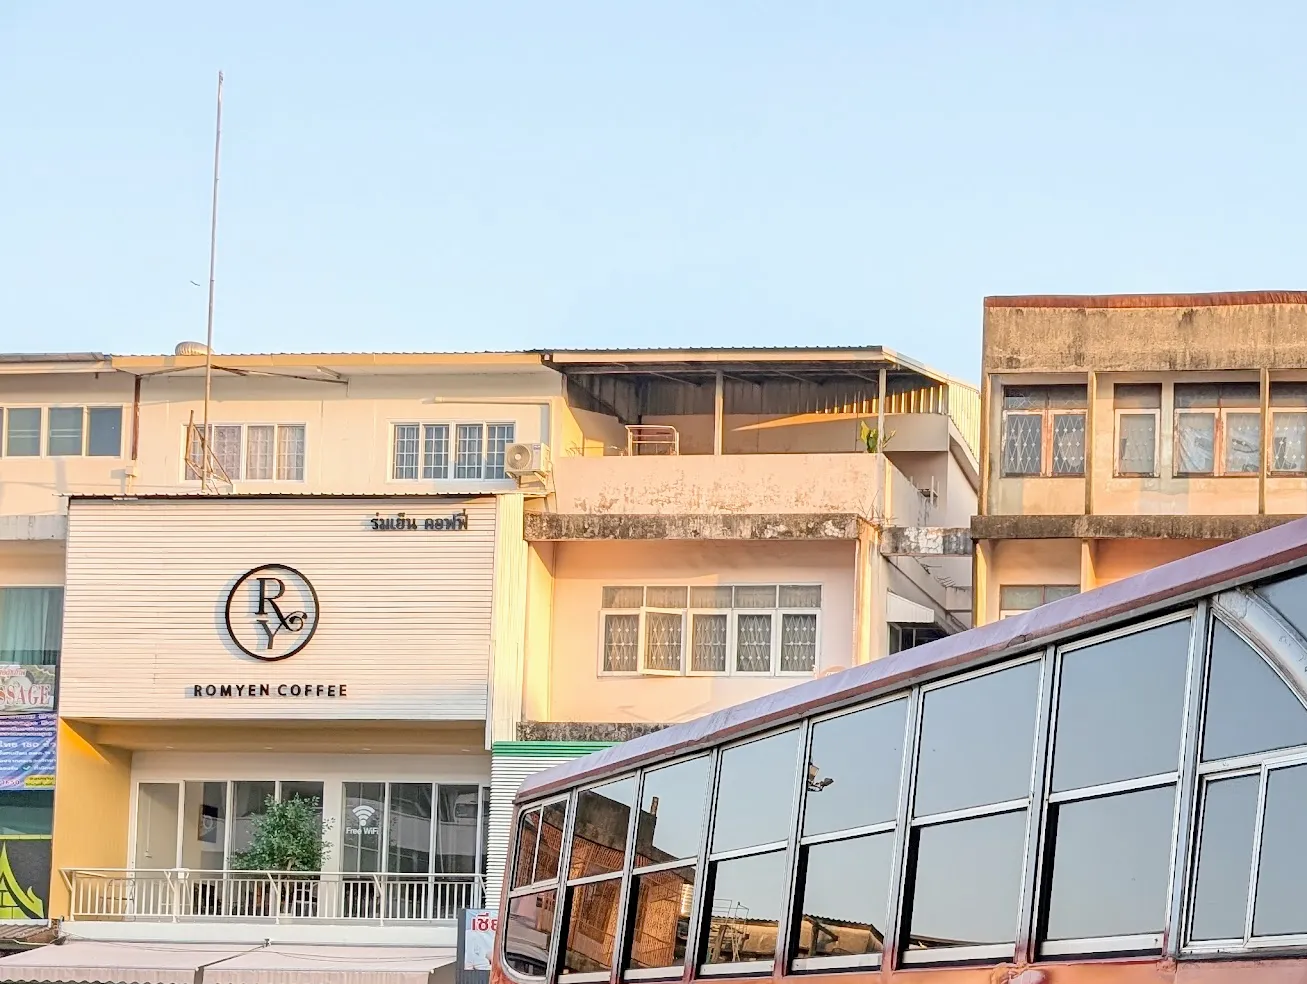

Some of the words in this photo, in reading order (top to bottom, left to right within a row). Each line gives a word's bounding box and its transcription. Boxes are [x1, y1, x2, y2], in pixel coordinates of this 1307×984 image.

[370, 511, 418, 530] ร่มเย็น
[424, 508, 468, 530] คอฟฟี่
[194, 683, 270, 697] ROMYEN
[277, 683, 347, 697] COFFEE
[346, 827, 362, 835] Free
[363, 827, 379, 835] WiFi
